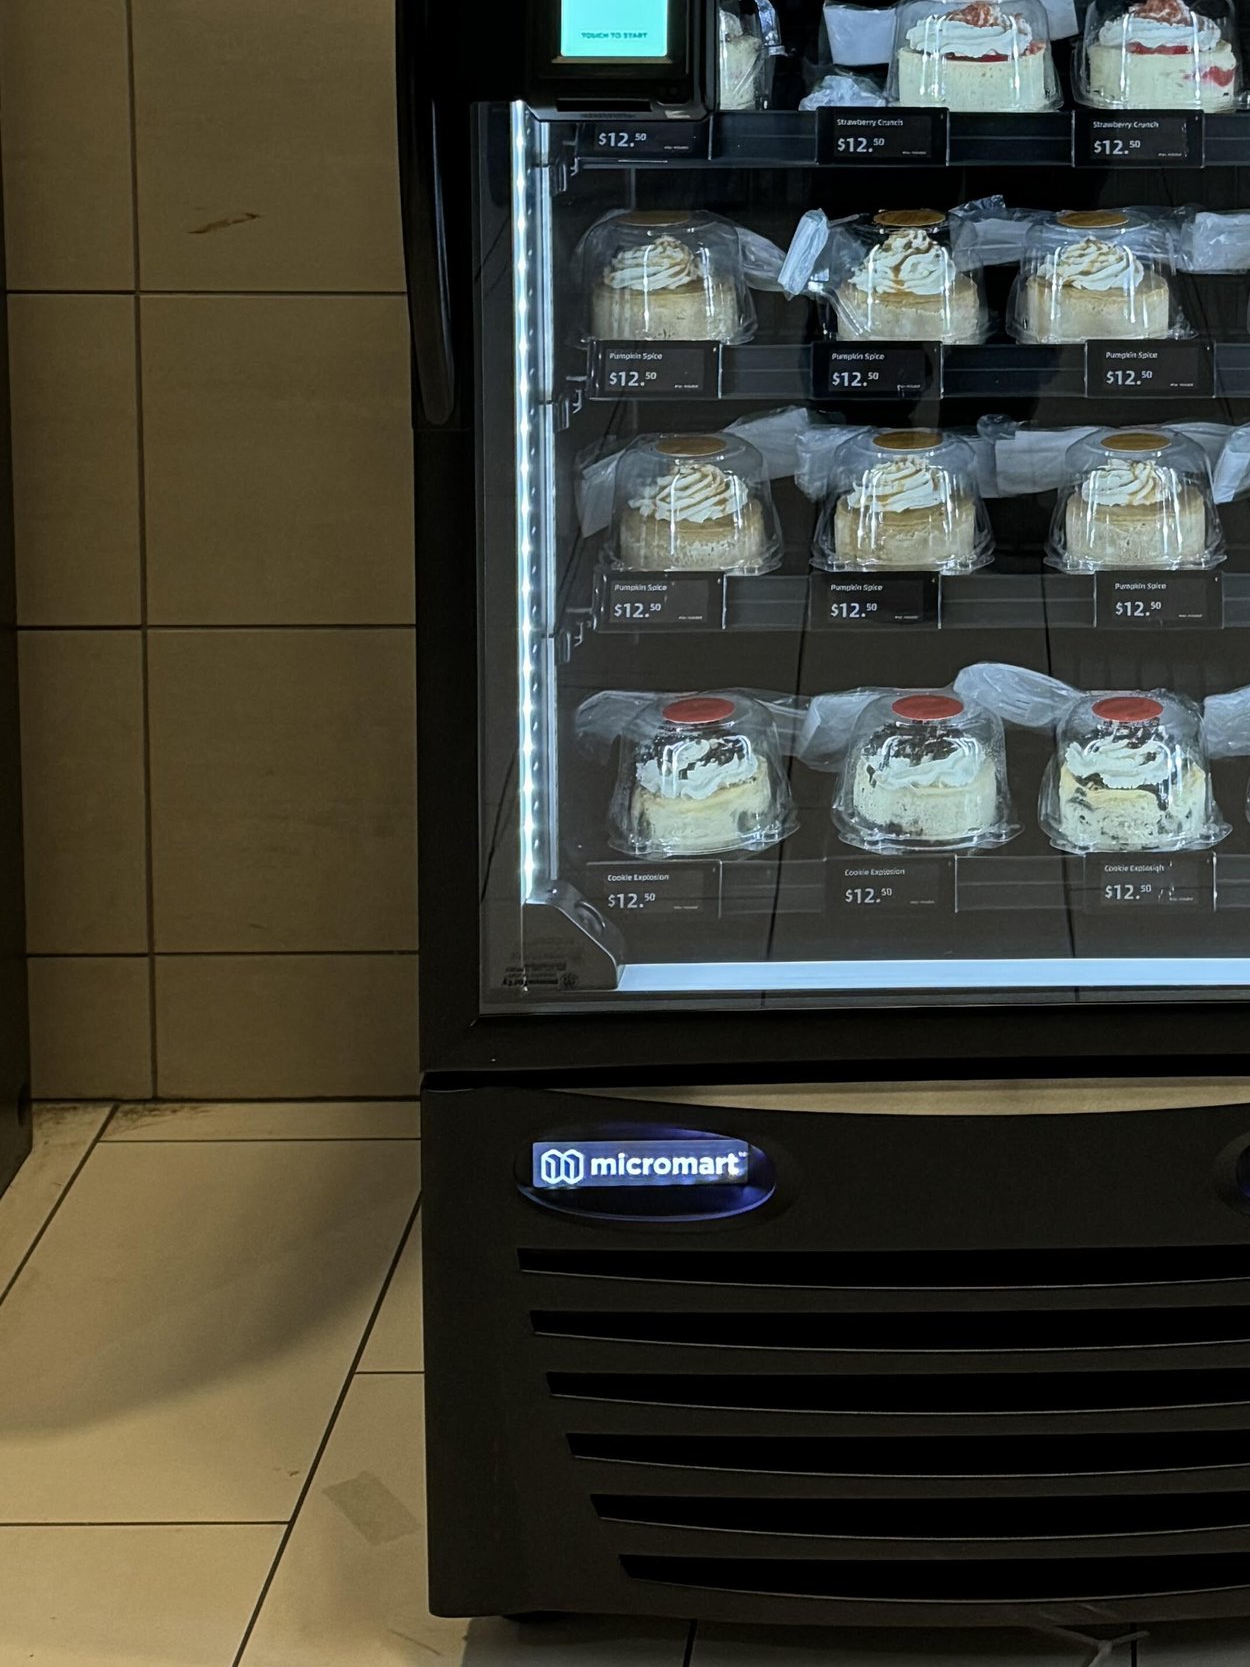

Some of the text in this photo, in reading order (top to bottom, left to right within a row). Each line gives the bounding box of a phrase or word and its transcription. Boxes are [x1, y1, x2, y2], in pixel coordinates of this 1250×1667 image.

[837, 118, 903, 127] Strawberry Crunch
[1093, 121, 1159, 129] Strawberry Crunch
[590, 1152, 740, 1176] micromart
